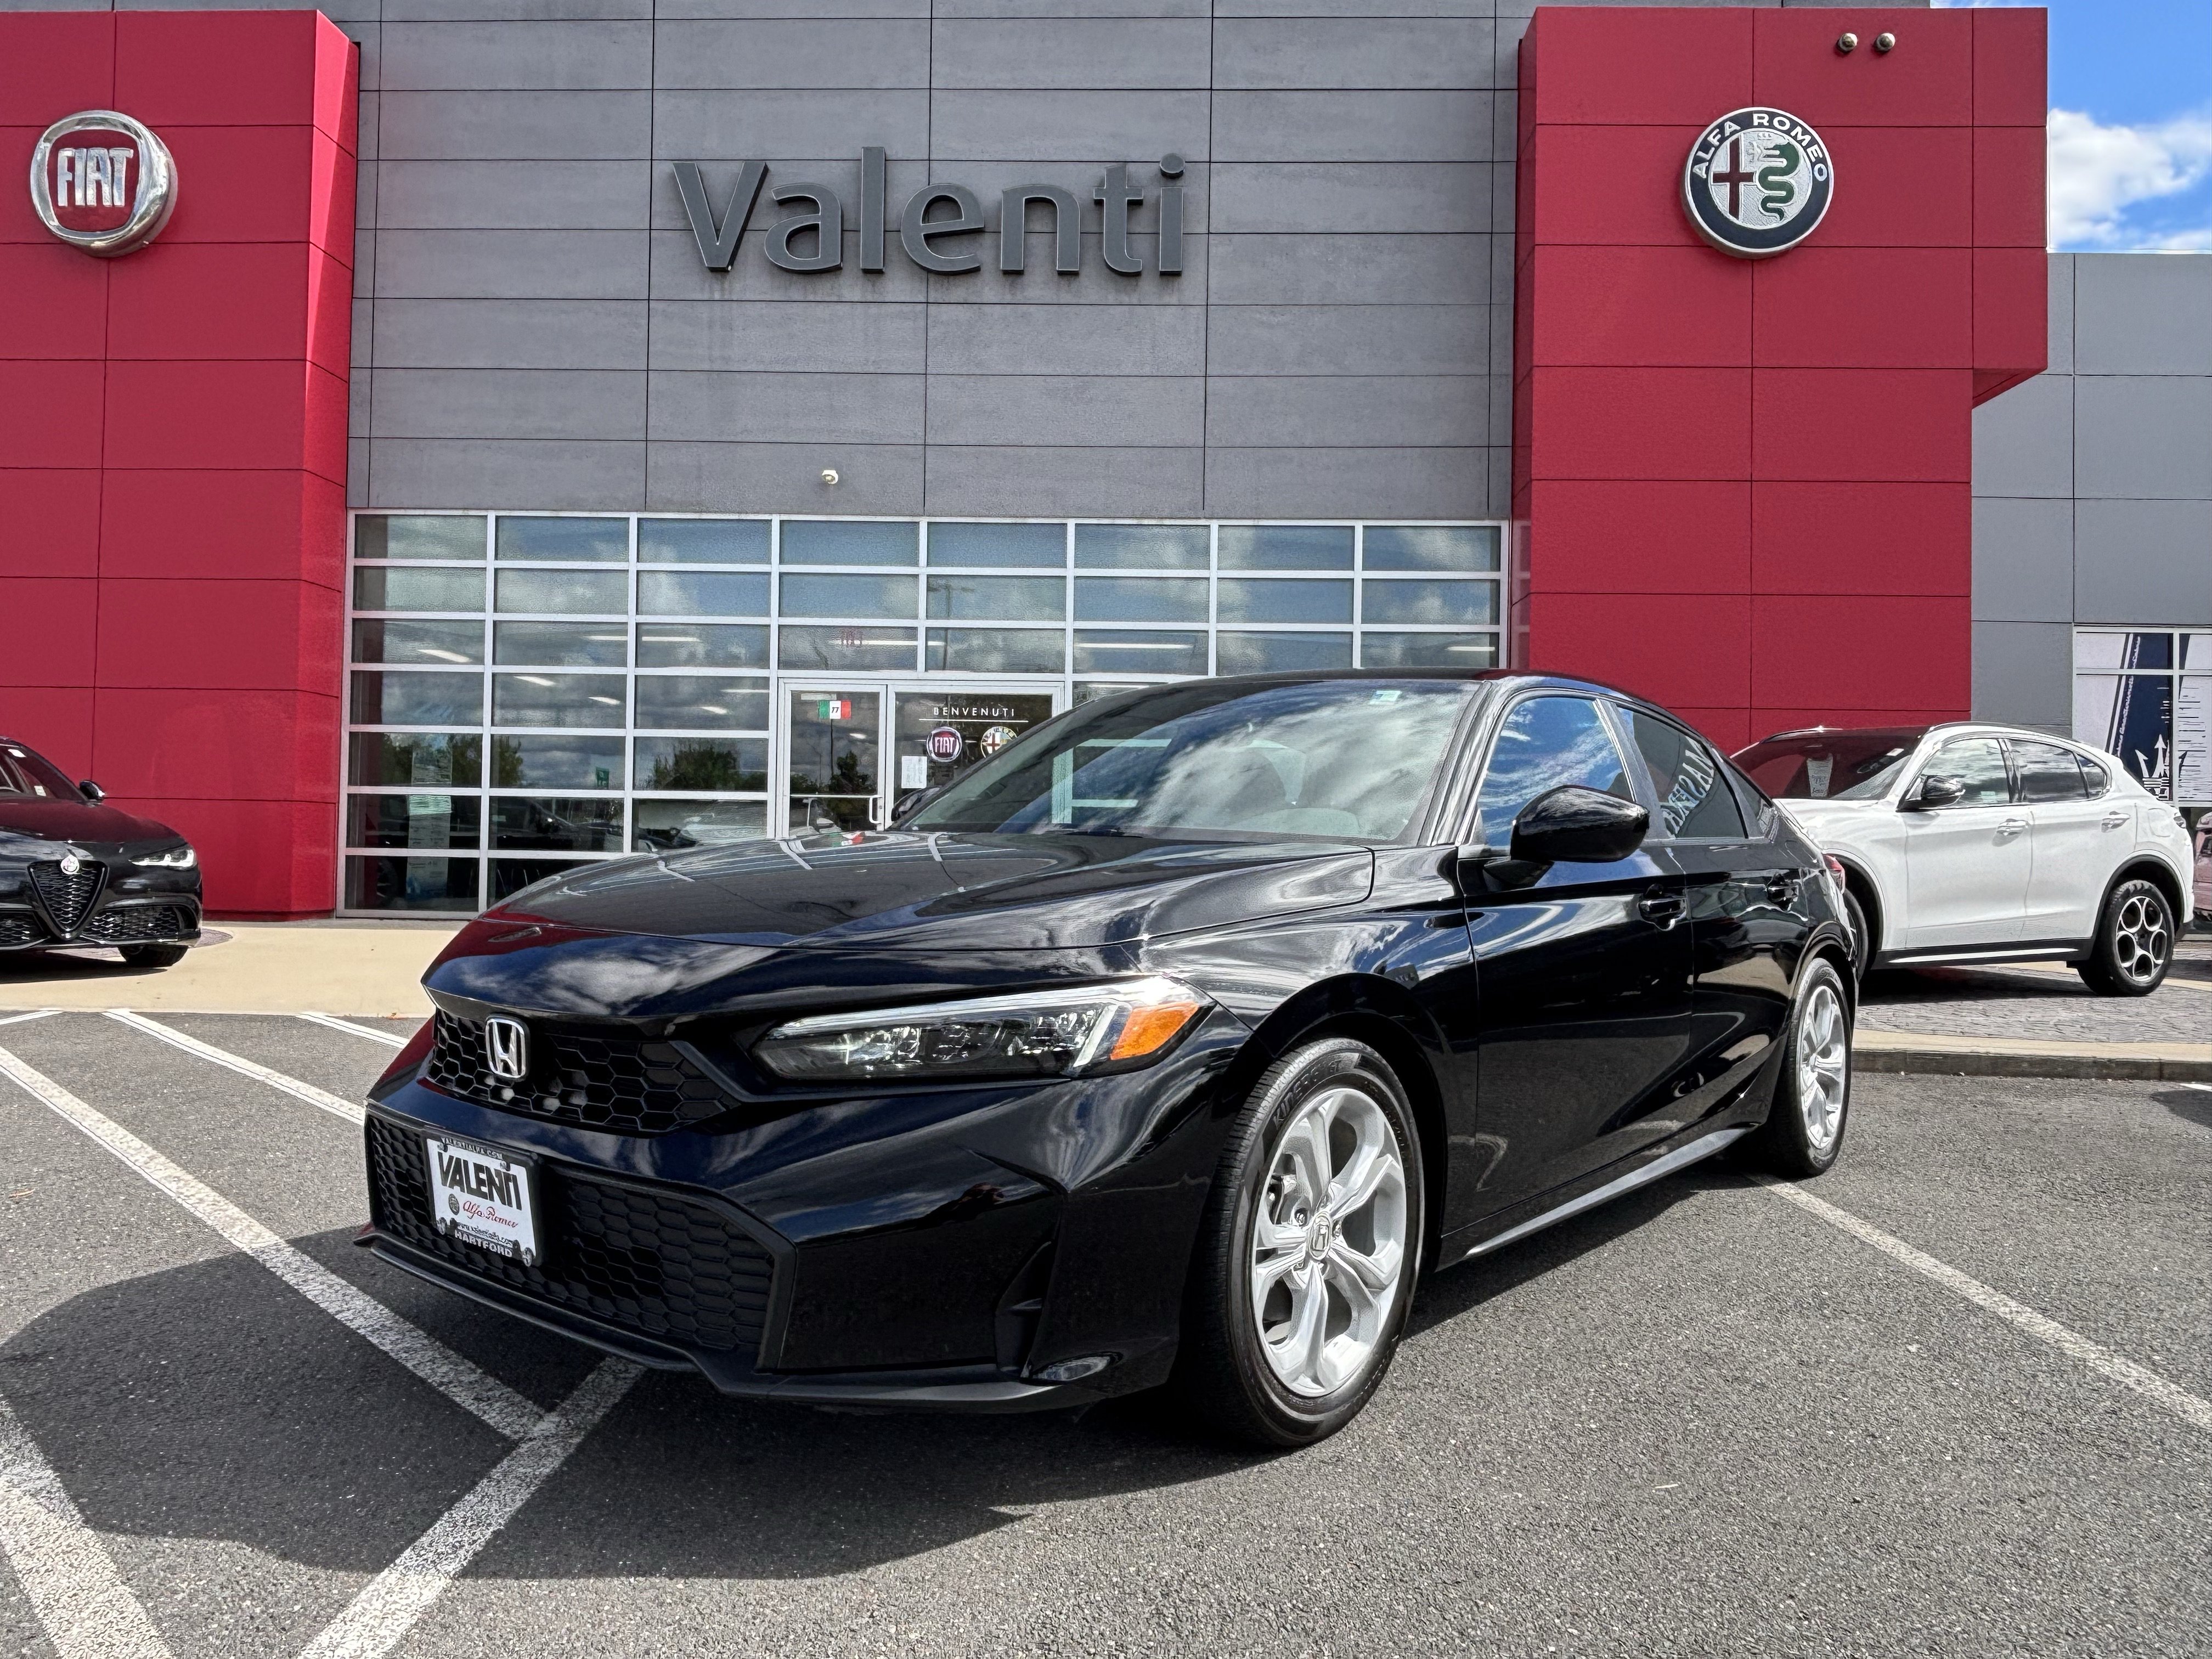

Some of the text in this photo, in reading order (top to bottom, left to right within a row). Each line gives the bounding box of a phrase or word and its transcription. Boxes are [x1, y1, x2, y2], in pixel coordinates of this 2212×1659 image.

[1692, 112, 1828, 182] ALFA ROMEO
[58, 147, 134, 207] FIAT
[672, 146, 1186, 276] Valenti
[933, 707, 1014, 717] BENVENUTI
[934, 736, 955, 753] FIAT
[437, 1151, 522, 1211] VALENTI
[462, 1200, 485, 1220] Alfa
[454, 1229, 513, 1258] HARTFORD
